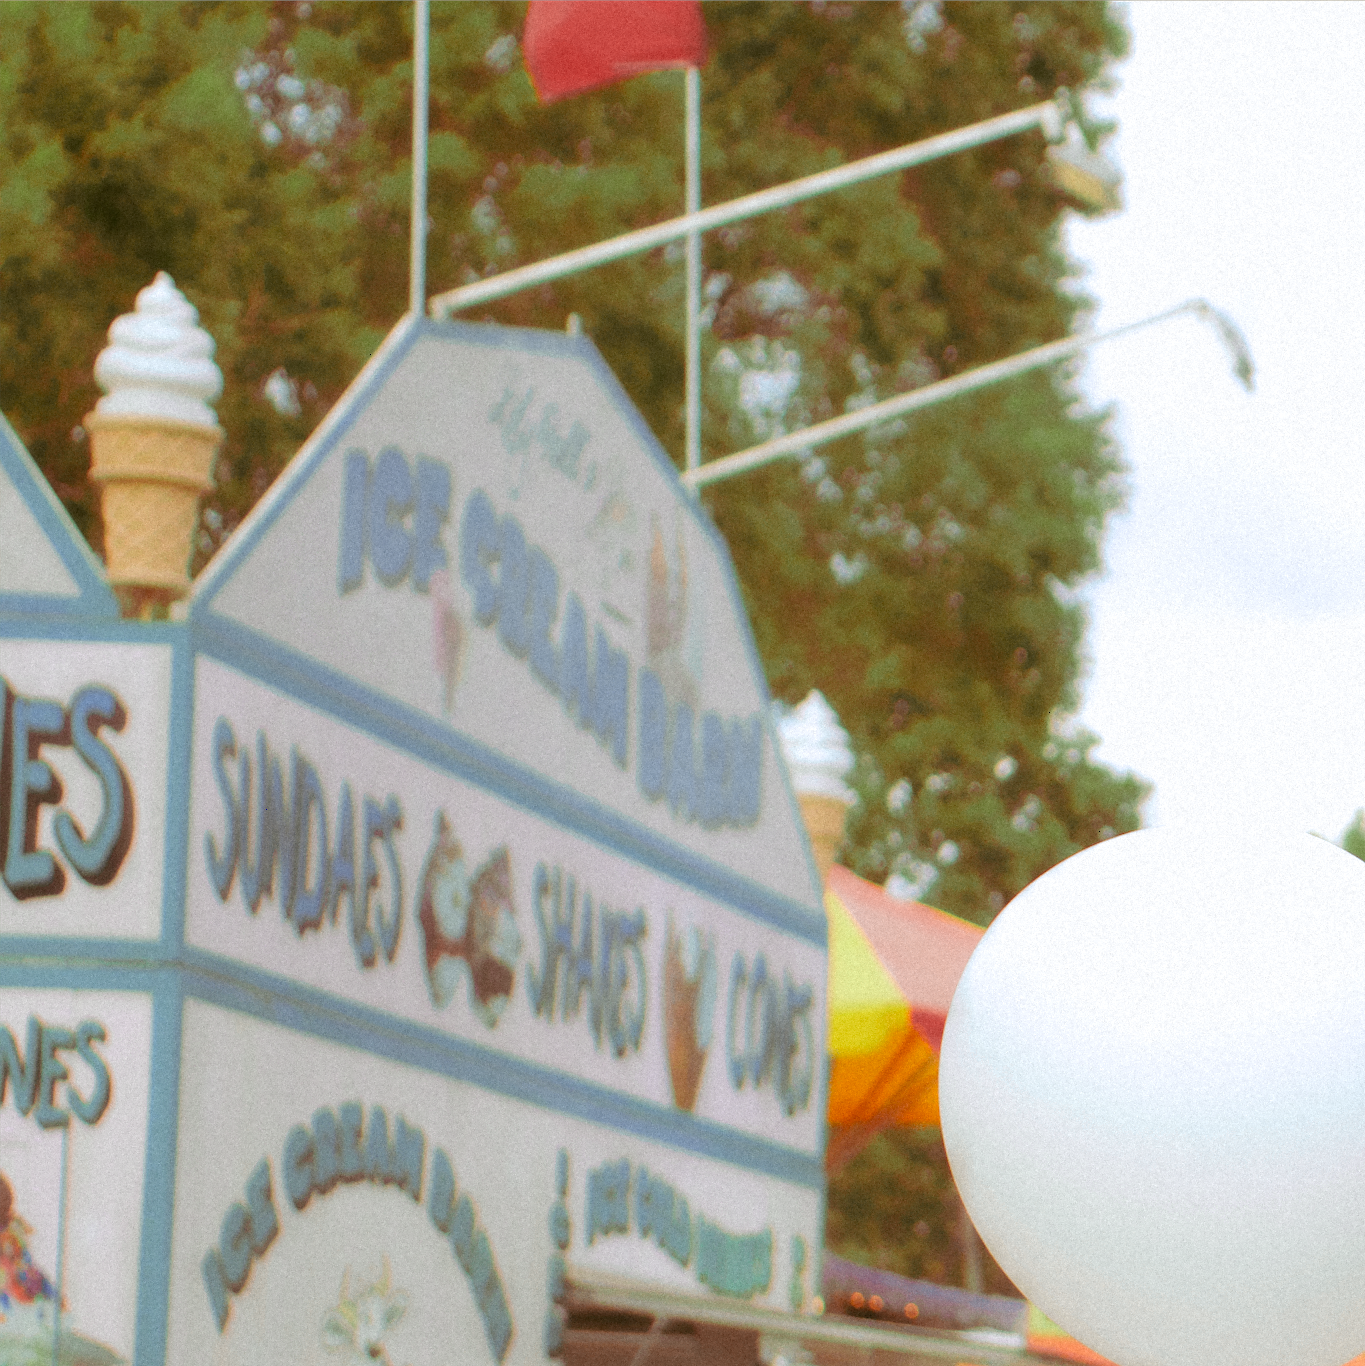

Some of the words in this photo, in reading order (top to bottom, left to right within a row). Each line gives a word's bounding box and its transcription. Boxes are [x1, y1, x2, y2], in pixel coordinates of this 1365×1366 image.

[338, 445, 452, 597] ICE
[461, 488, 630, 771] CREAM
[0, 674, 137, 900] ES
[205, 715, 404, 972] SUNDAES
[525, 861, 648, 1059] SHAKES
[727, 951, 813, 1117] CONES
[201, 1152, 281, 1336] ICE
[282, 1100, 427, 1213] CREAM
